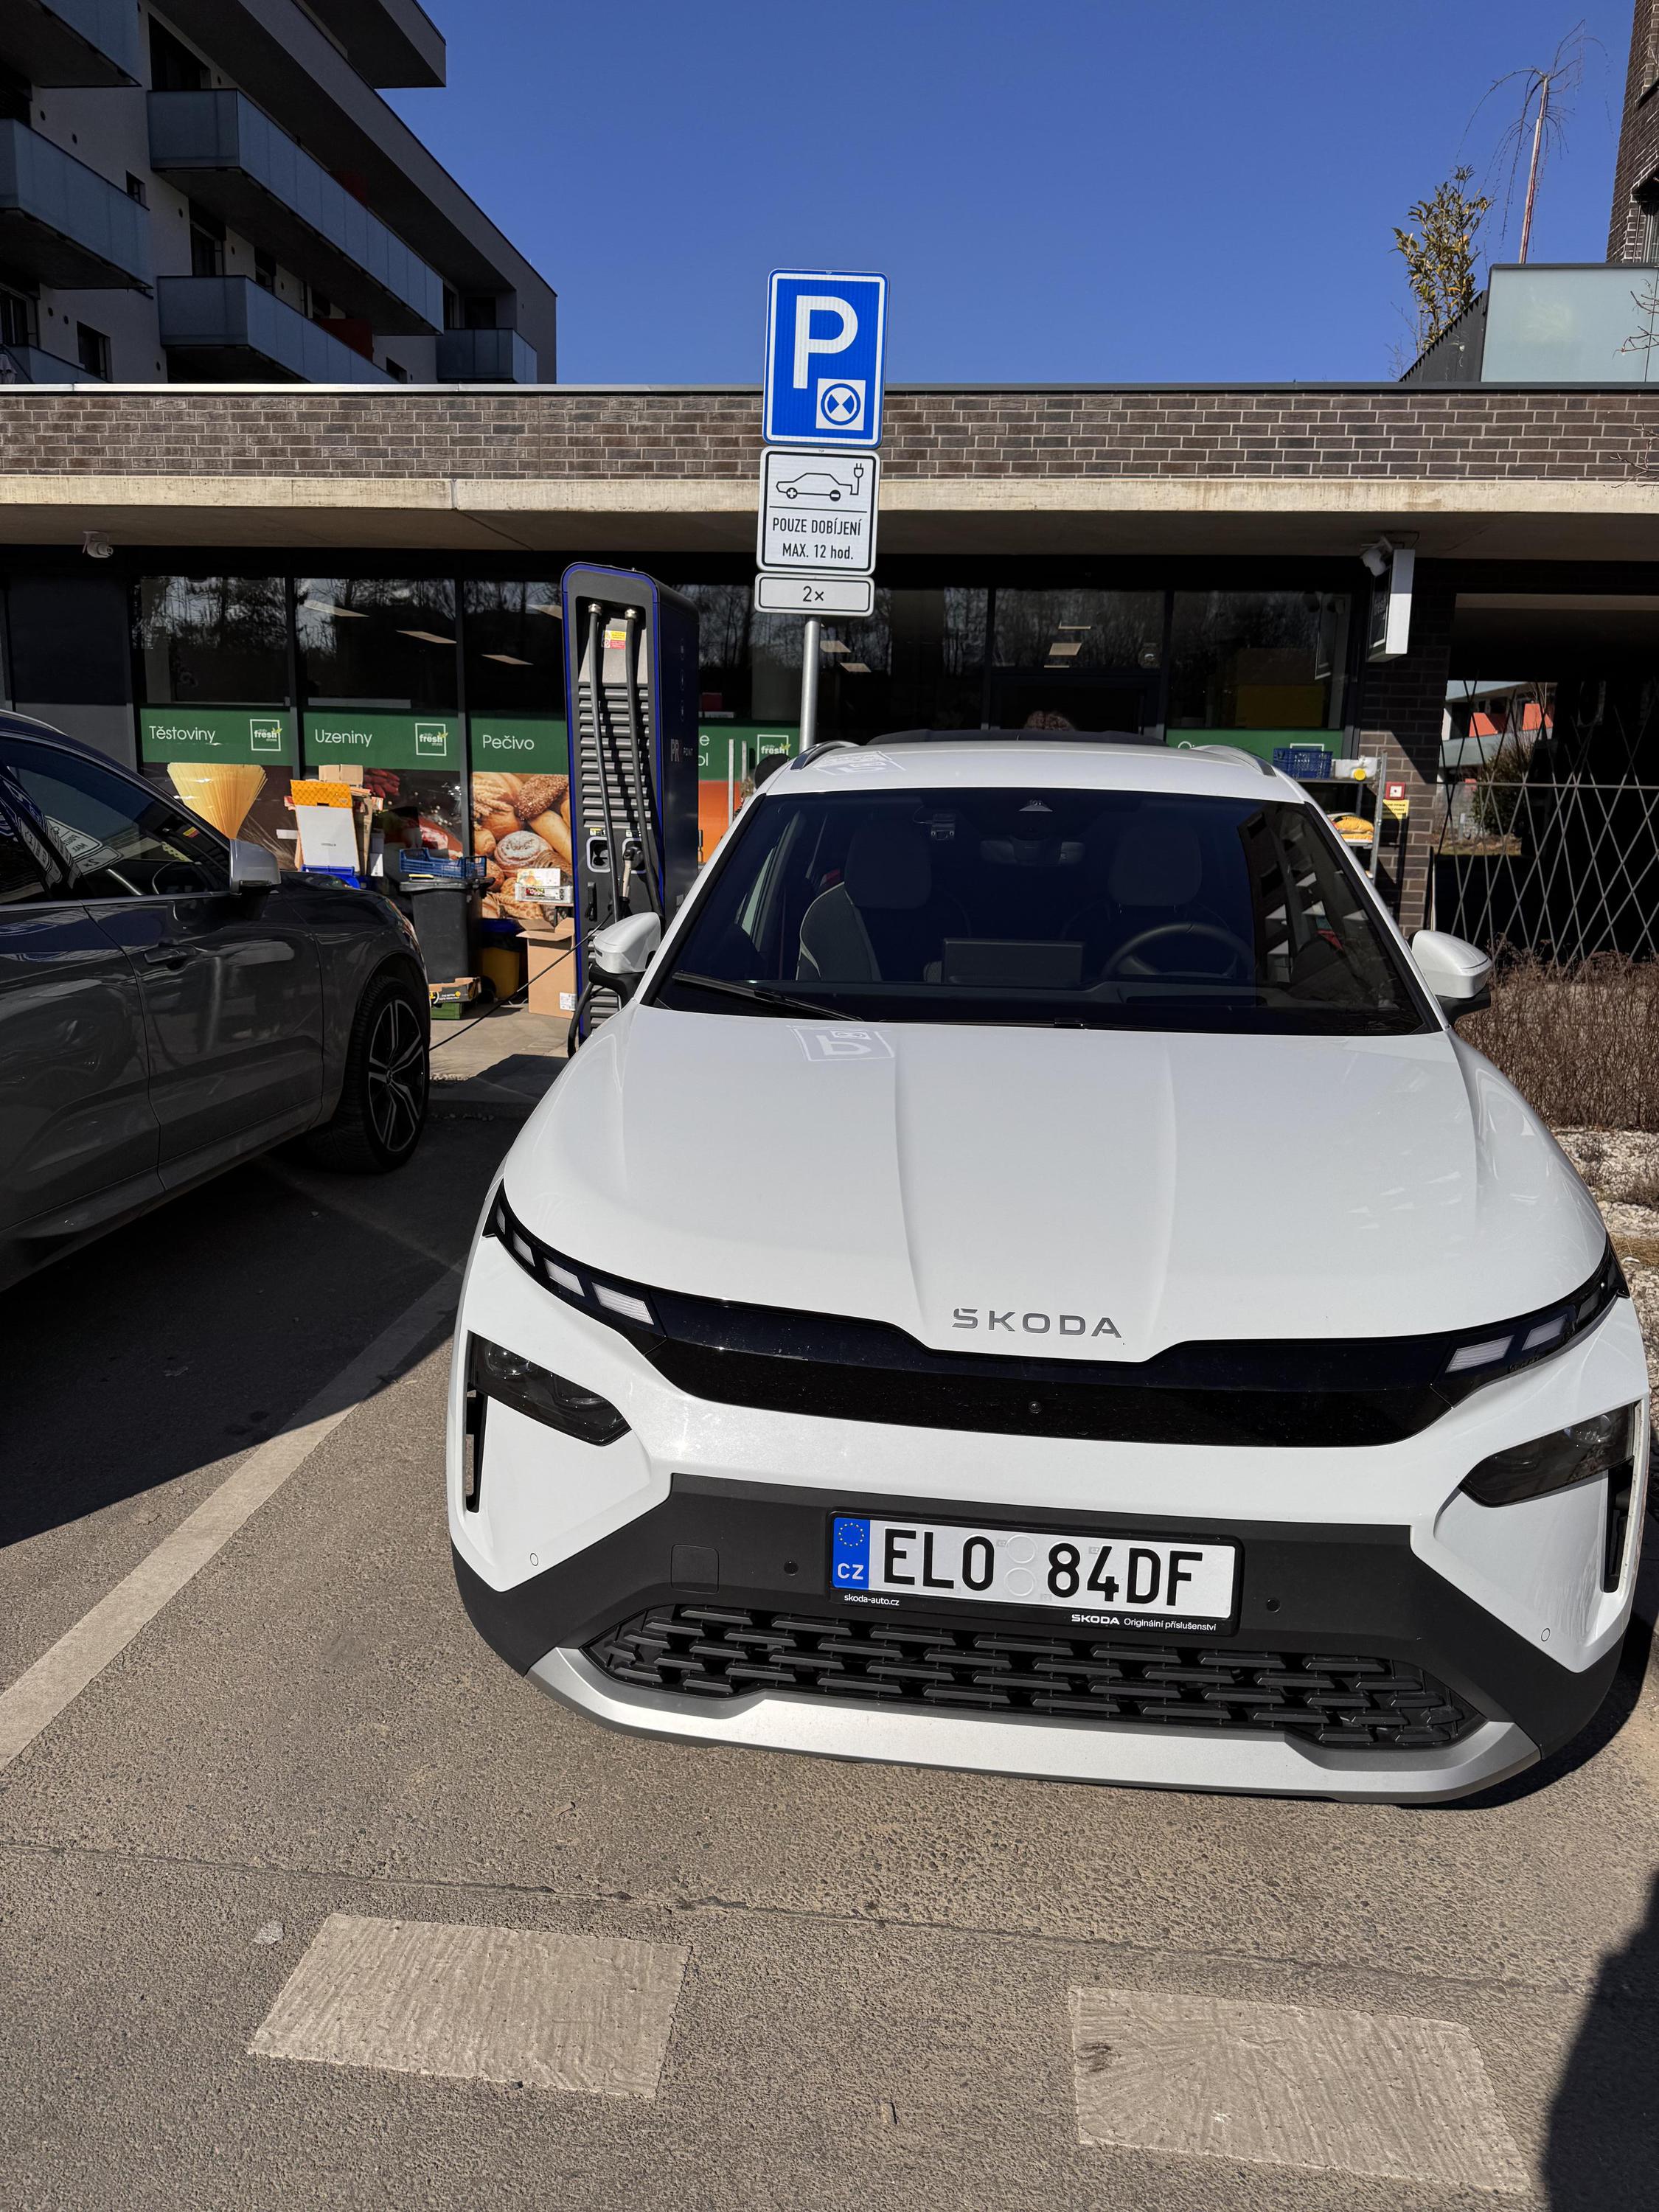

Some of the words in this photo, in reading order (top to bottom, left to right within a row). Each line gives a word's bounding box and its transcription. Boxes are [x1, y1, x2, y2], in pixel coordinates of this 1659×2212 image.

[793, 295, 858, 389] P
[772, 517, 807, 533] POUZE
[811, 517, 863, 536] DOBÍJENÍ
[782, 543, 809, 558] MAX.
[813, 543, 827, 558] 12
[830, 545, 854, 560] hod.
[148, 726, 216, 744] Těstoviny
[254, 729, 278, 739] fresh
[315, 728, 373, 748] Uzeniny
[419, 733, 443, 742] fresh
[482, 734, 535, 751] Pečivo
[760, 745, 785, 754] fresh
[837, 1562, 864, 1580] CZ
[1047, 1543, 1203, 1607] 84DF
[844, 1593, 900, 1606] skoda-auto.cz
[1124, 1618, 1164, 1629] Originální
[1164, 1620, 1217, 1632] příslušenství
